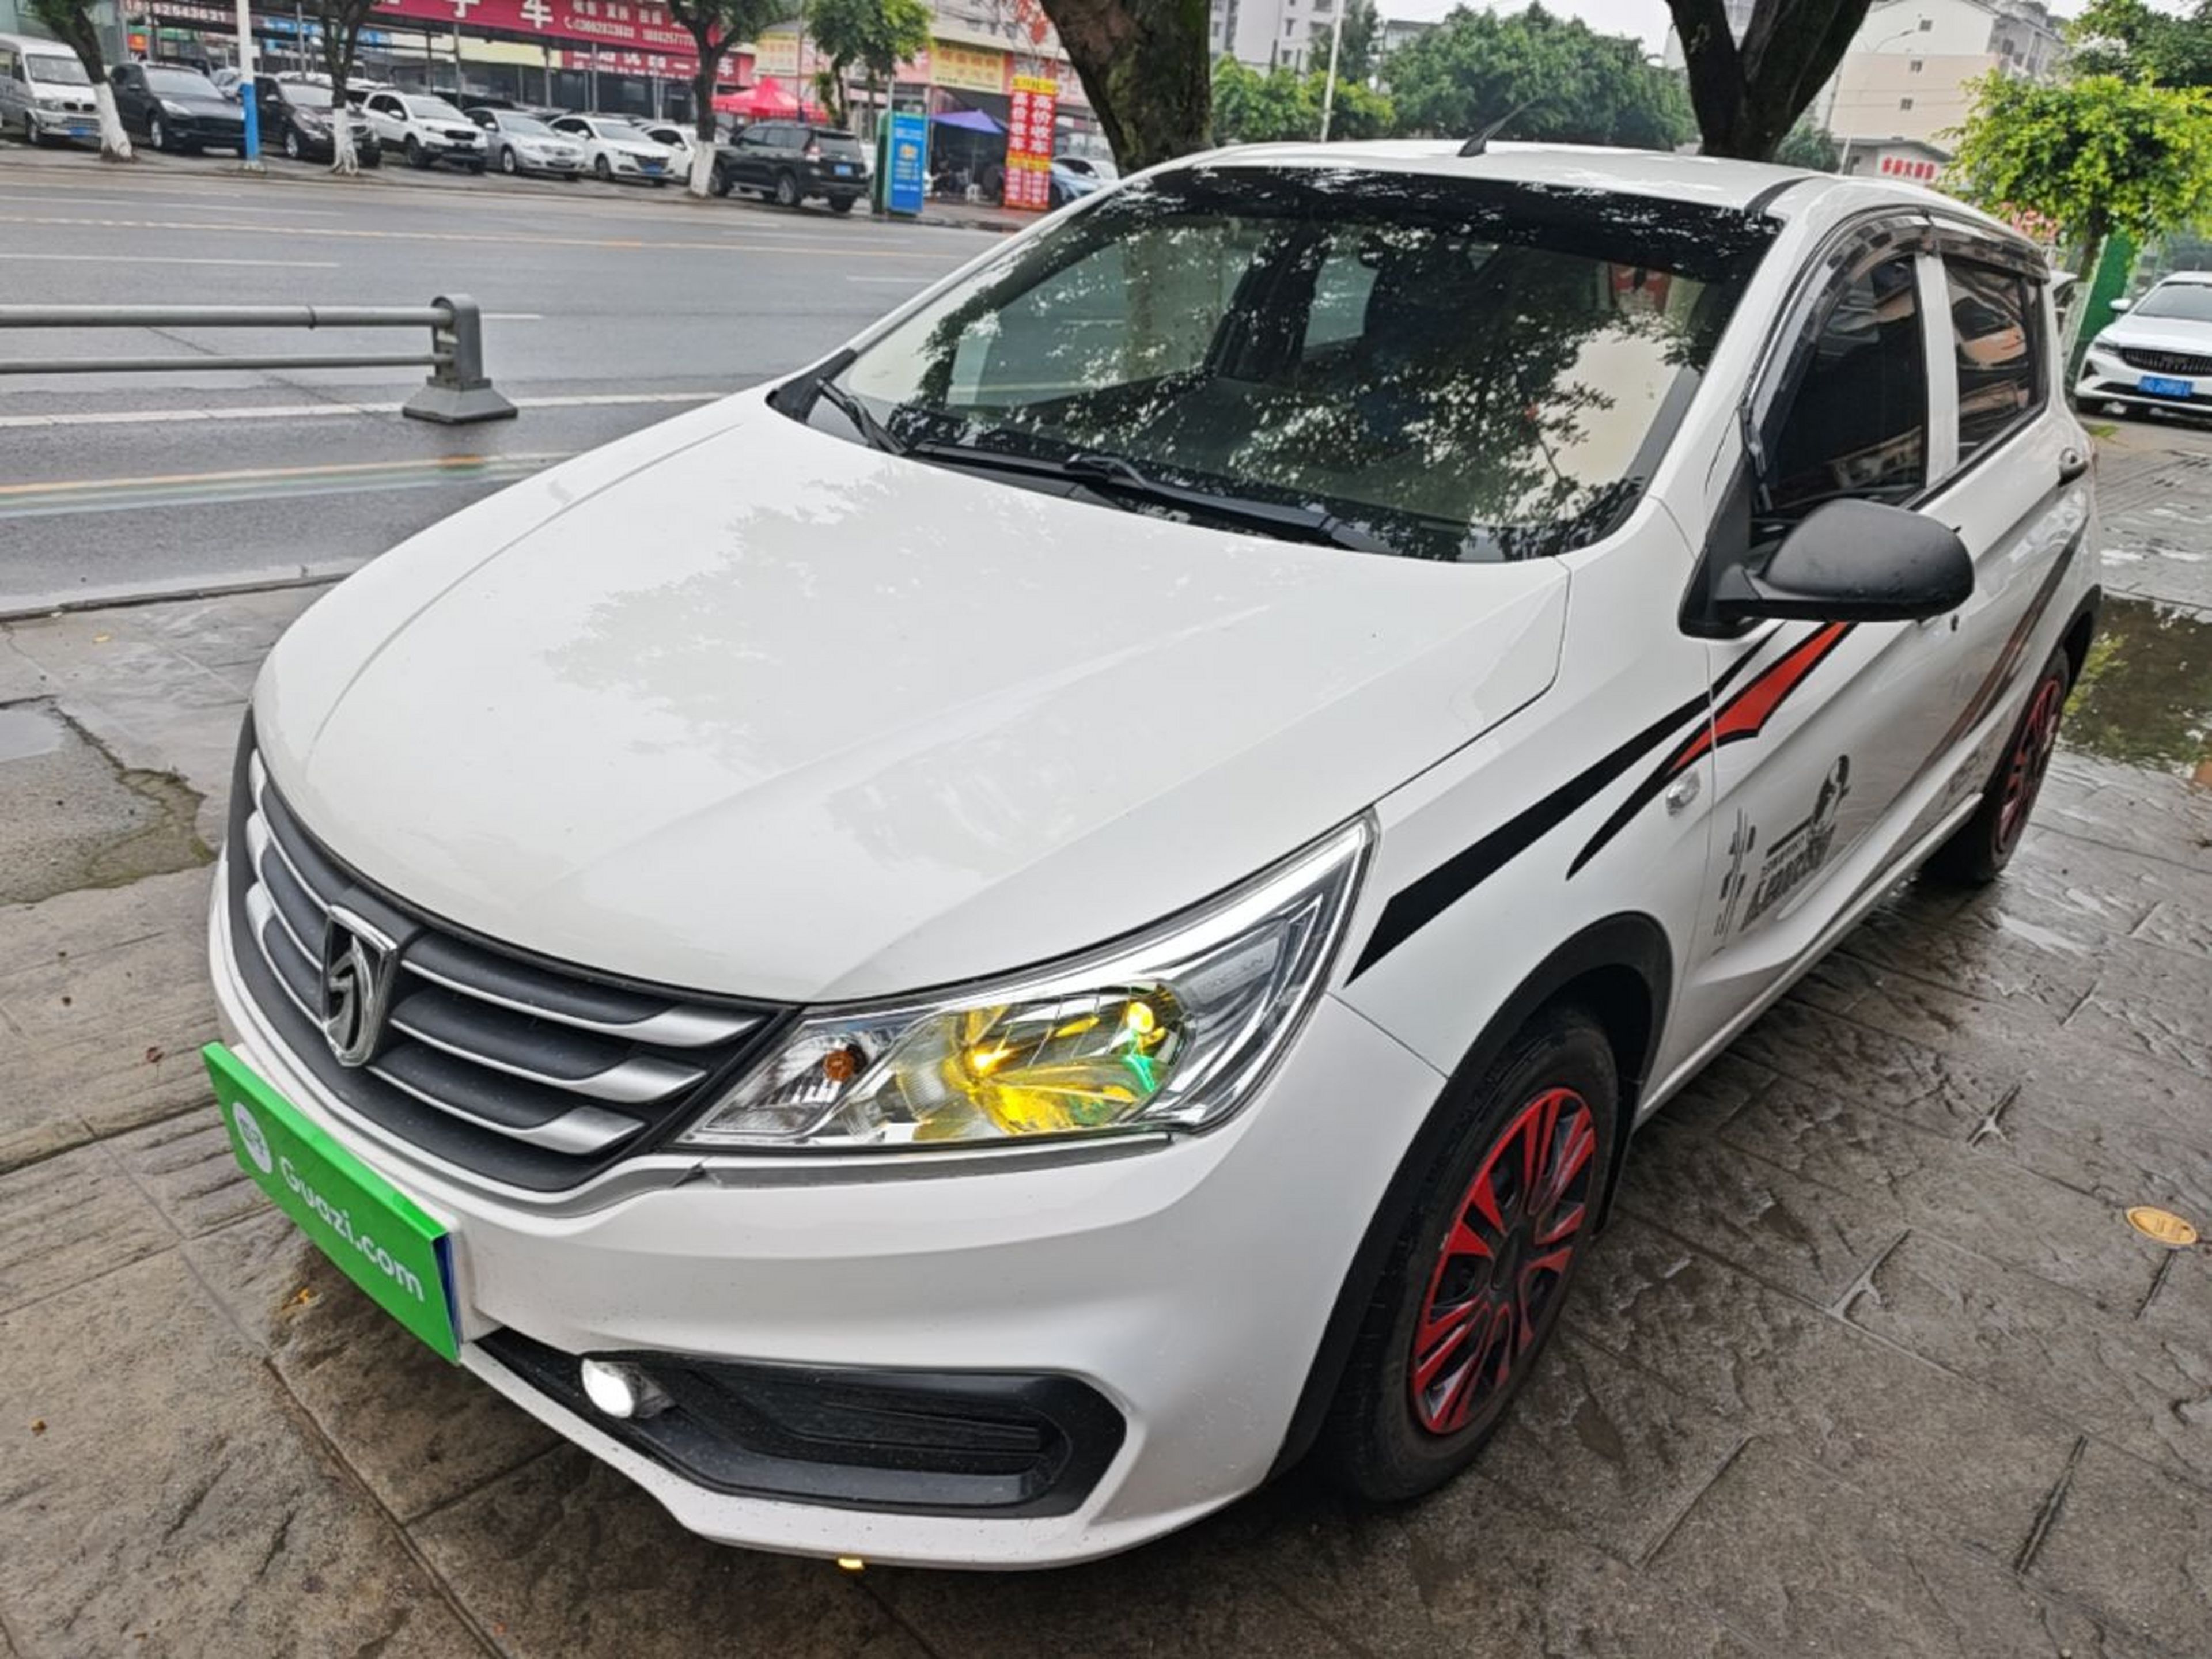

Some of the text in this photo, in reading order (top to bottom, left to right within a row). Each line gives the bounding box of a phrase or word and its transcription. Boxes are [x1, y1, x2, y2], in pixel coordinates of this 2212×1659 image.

[1029, 94, 1052, 154] 高价收车
[279, 1156, 424, 1302] Guazi.com
